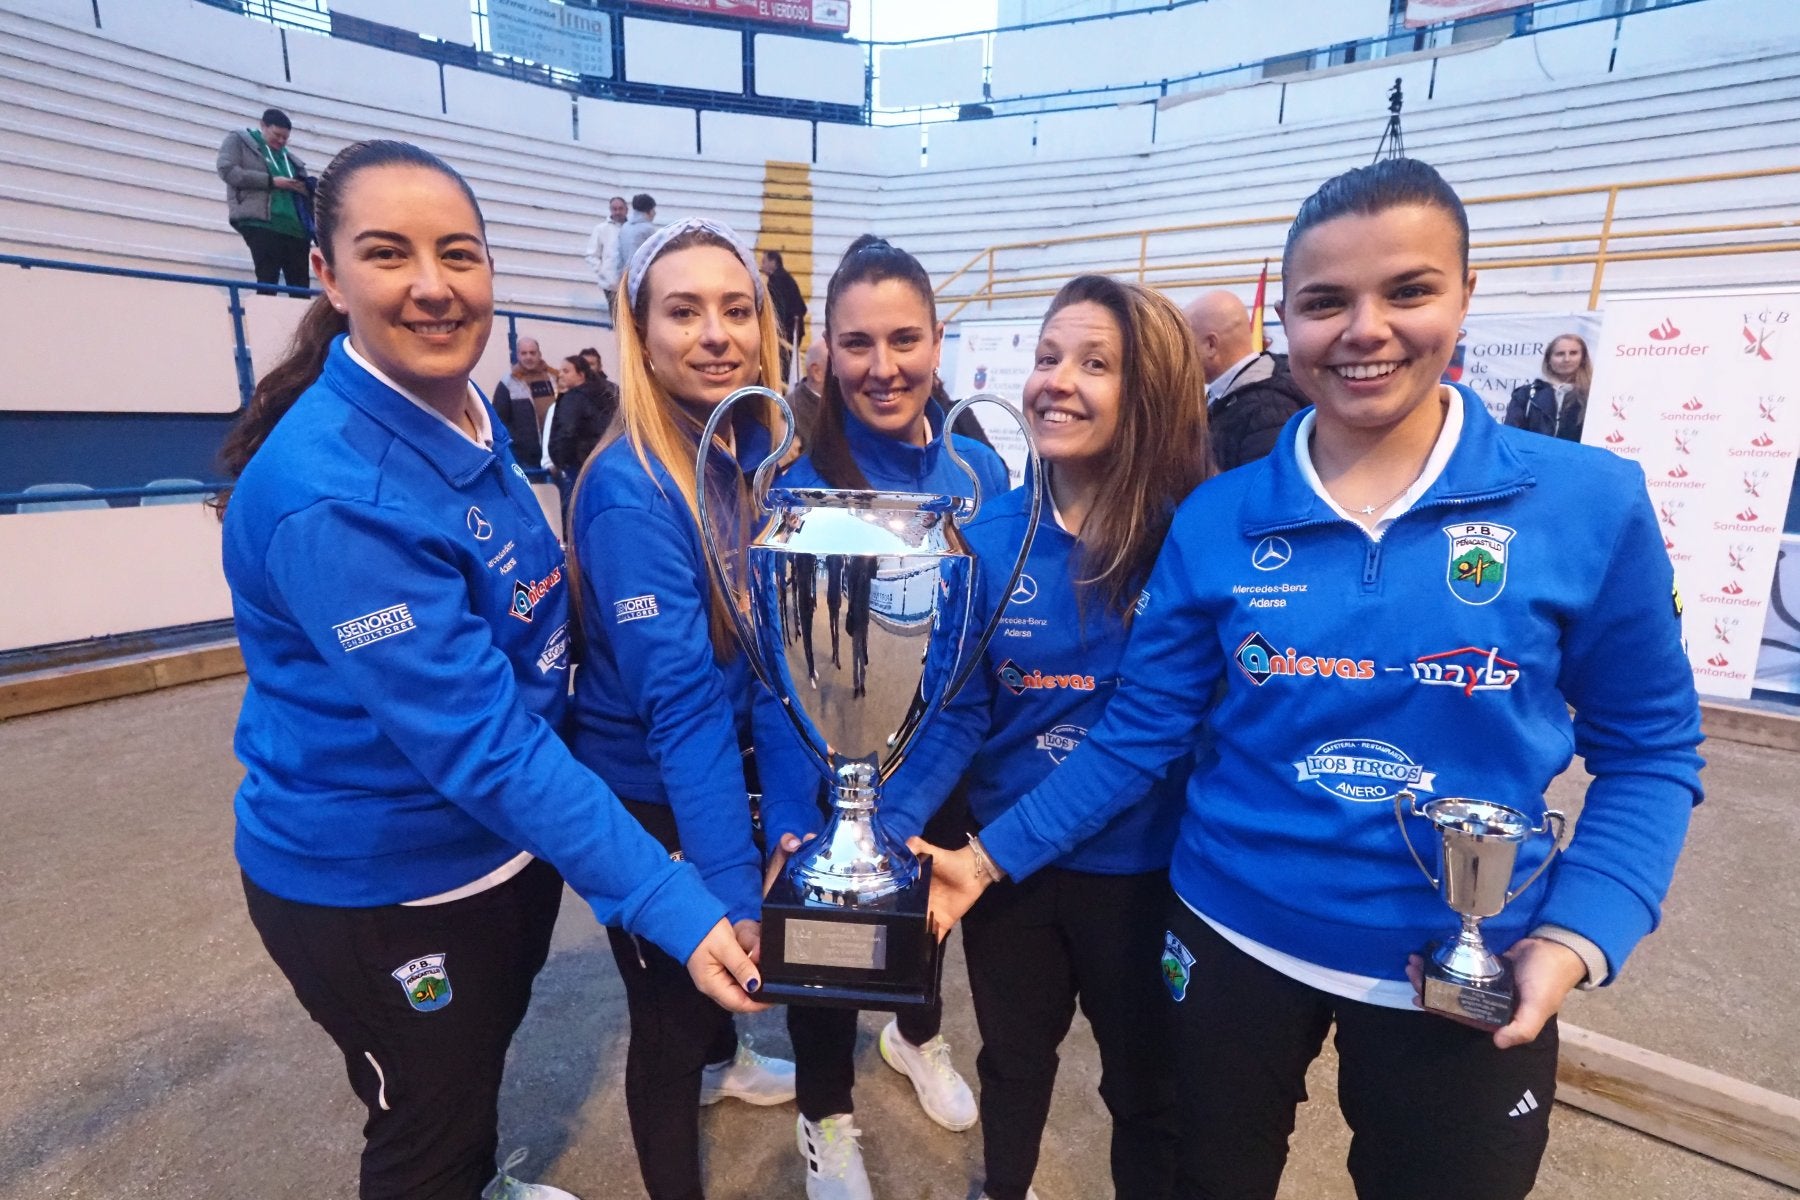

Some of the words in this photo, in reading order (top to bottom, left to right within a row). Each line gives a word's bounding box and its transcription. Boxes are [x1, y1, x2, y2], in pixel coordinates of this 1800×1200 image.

[760, 1, 769, 16] EL
[1473, 343, 1545, 357] GOBIER
[1616, 343, 1710, 357] Santander
[1471, 362, 1488, 374] de
[1660, 412, 1723, 422] Santander
[1605, 446, 1641, 455] tander
[1728, 447, 1793, 459] Santander
[1647, 478, 1707, 490] Santander
[1713, 521, 1778, 534] Santander
[1232, 583, 1309, 594] Mercedes-Benz
[1249, 597, 1287, 608] Adarsa
[1699, 593, 1763, 608] Santander
[336, 606, 412, 641] ASENORTE
[342, 619, 414, 649] CONSULTORES
[1241, 644, 1376, 681] anievas
[1001, 666, 1096, 692] anievas
[1692, 667, 1748, 680] antander
[1047, 735, 1069, 748] LOS
[1308, 756, 1347, 774] LOS
[1352, 758, 1419, 782] ARCOS
[1336, 781, 1388, 798] ANERO
